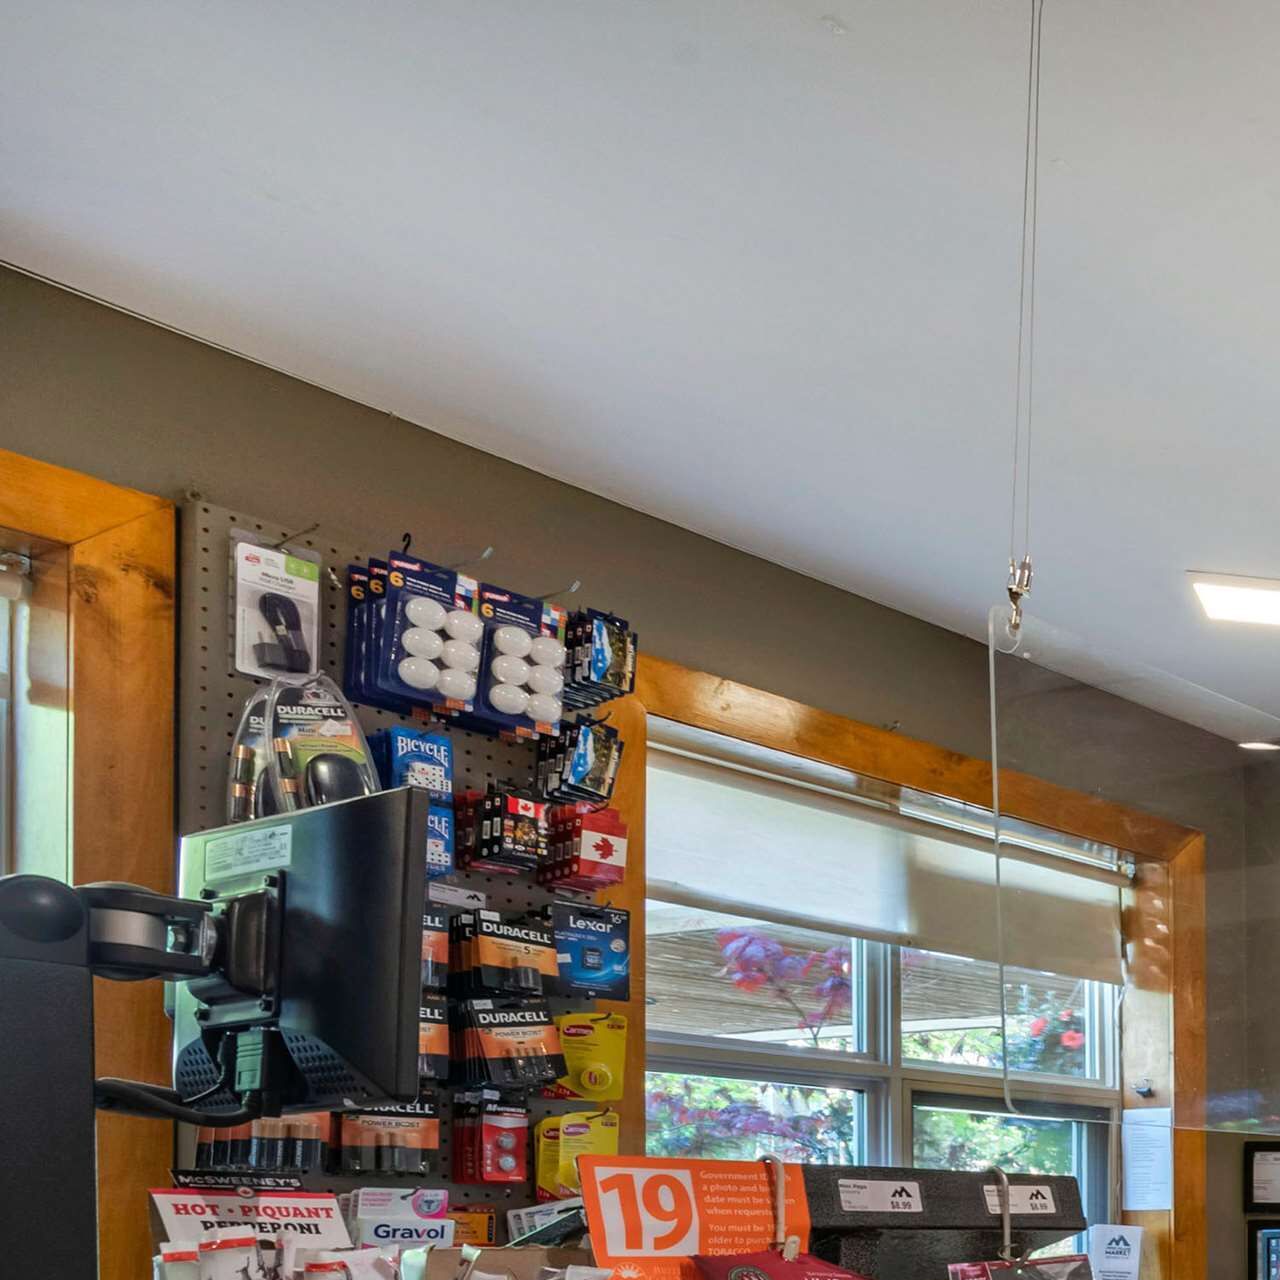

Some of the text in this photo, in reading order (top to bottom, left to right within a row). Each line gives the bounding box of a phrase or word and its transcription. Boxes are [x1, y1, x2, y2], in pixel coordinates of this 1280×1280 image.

[389, 572, 404, 588] 6
[481, 601, 494, 618] 6
[277, 704, 345, 718] DURACELL
[397, 736, 449, 767] BICYCLE
[482, 921, 551, 944] DURACELL
[569, 915, 613, 934] Lexar
[479, 1011, 548, 1024] DURACELL
[178, 1174, 301, 1187] McSWEENEY'S
[173, 1203, 333, 1219] HOT PIQUANT
[600, 1173, 693, 1251] 19
[374, 1224, 445, 1240] Gravol
